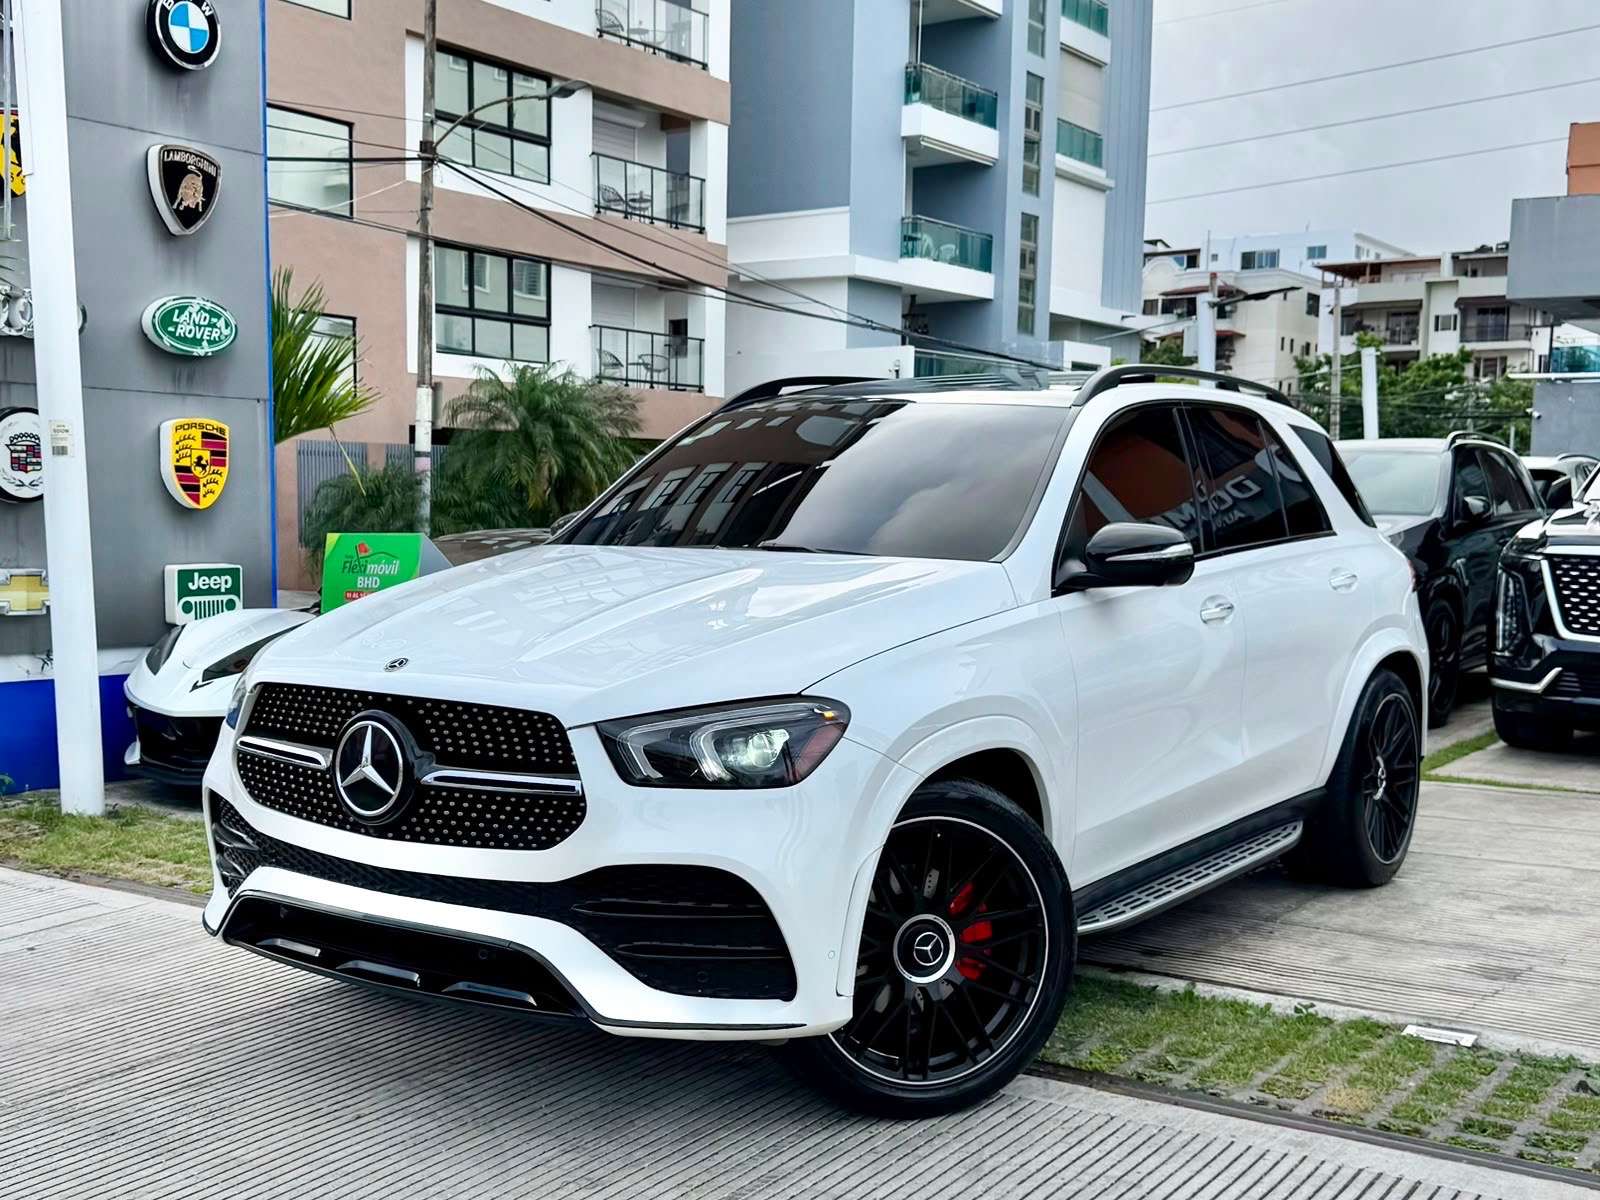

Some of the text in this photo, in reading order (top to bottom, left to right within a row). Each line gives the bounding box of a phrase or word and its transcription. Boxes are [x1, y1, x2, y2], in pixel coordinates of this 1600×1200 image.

[162, 0, 214, 16] BW
[163, 150, 217, 177] LAMBORGHINI
[172, 309, 210, 325] LAND
[175, 324, 221, 341] ROVER
[175, 422, 226, 436] PORSCHE
[187, 571, 233, 593] Jeep
[357, 576, 380, 588] BHD
